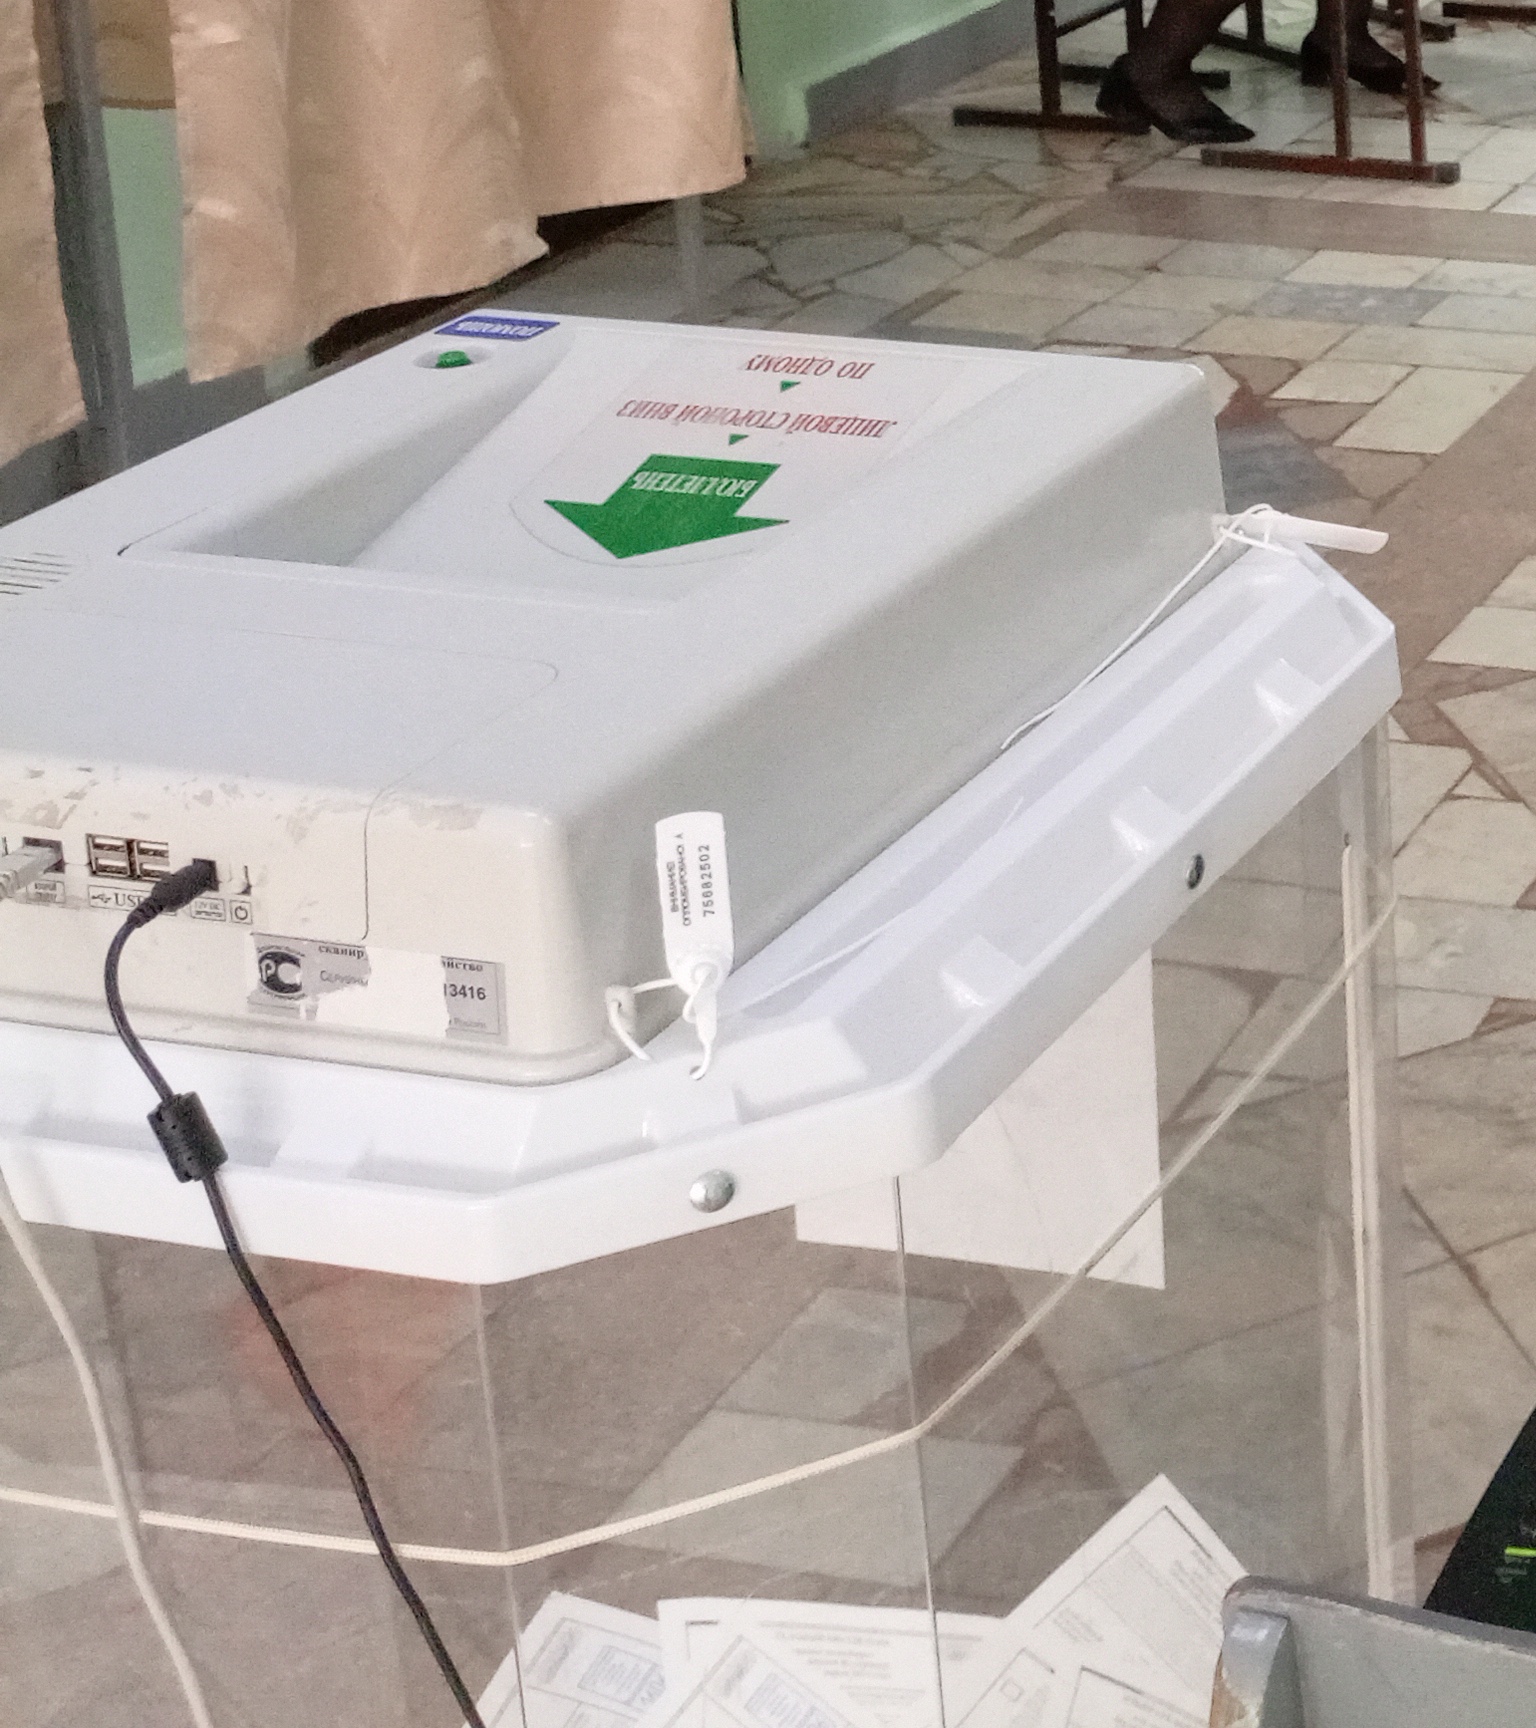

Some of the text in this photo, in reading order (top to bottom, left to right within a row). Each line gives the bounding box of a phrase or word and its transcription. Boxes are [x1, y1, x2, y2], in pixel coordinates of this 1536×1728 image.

[747, 354, 876, 379] ПО ОДНОМУ
[616, 399, 897, 438] ЛИЦЕВОЙ СТОРОНОЙ ВНИЗ
[630, 471, 758, 498] БЮЛЛЕТЕНЬ
